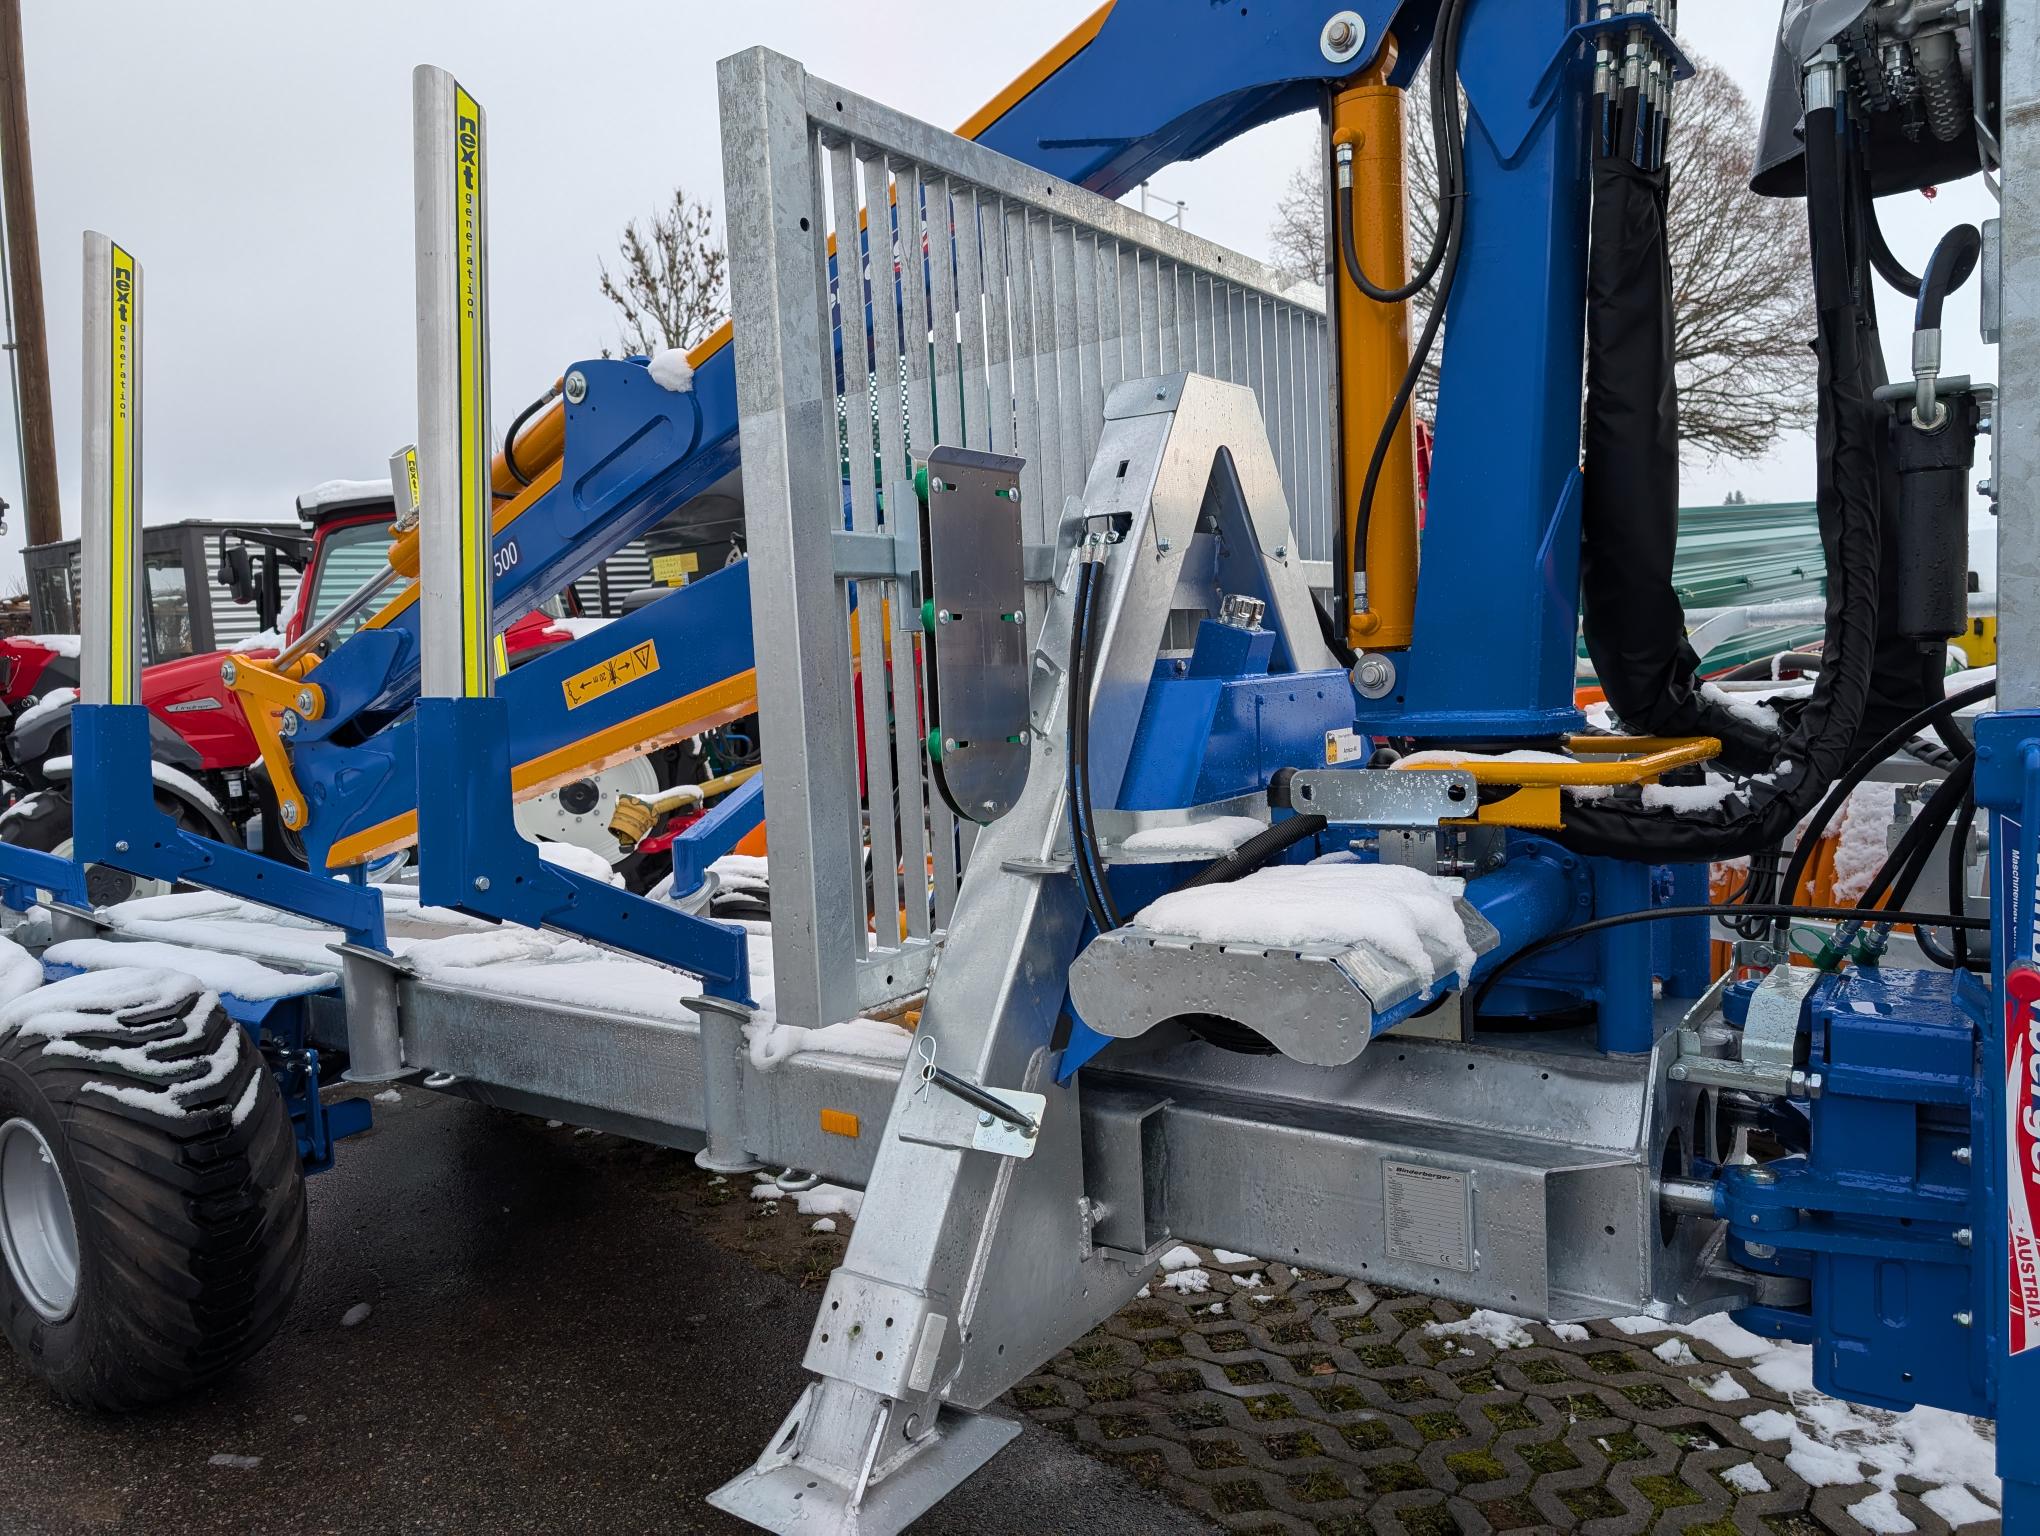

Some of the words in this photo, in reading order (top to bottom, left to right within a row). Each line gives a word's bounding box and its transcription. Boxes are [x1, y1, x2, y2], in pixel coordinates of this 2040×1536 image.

[459, 115, 476, 190] next
[465, 192, 473, 319] generation
[115, 266, 131, 322] next
[408, 460, 417, 488] next
[493, 541, 518, 577] 500
[1395, 1167, 1452, 1180] Binderberger
[2016, 1234, 2040, 1319] AUSTRIA
